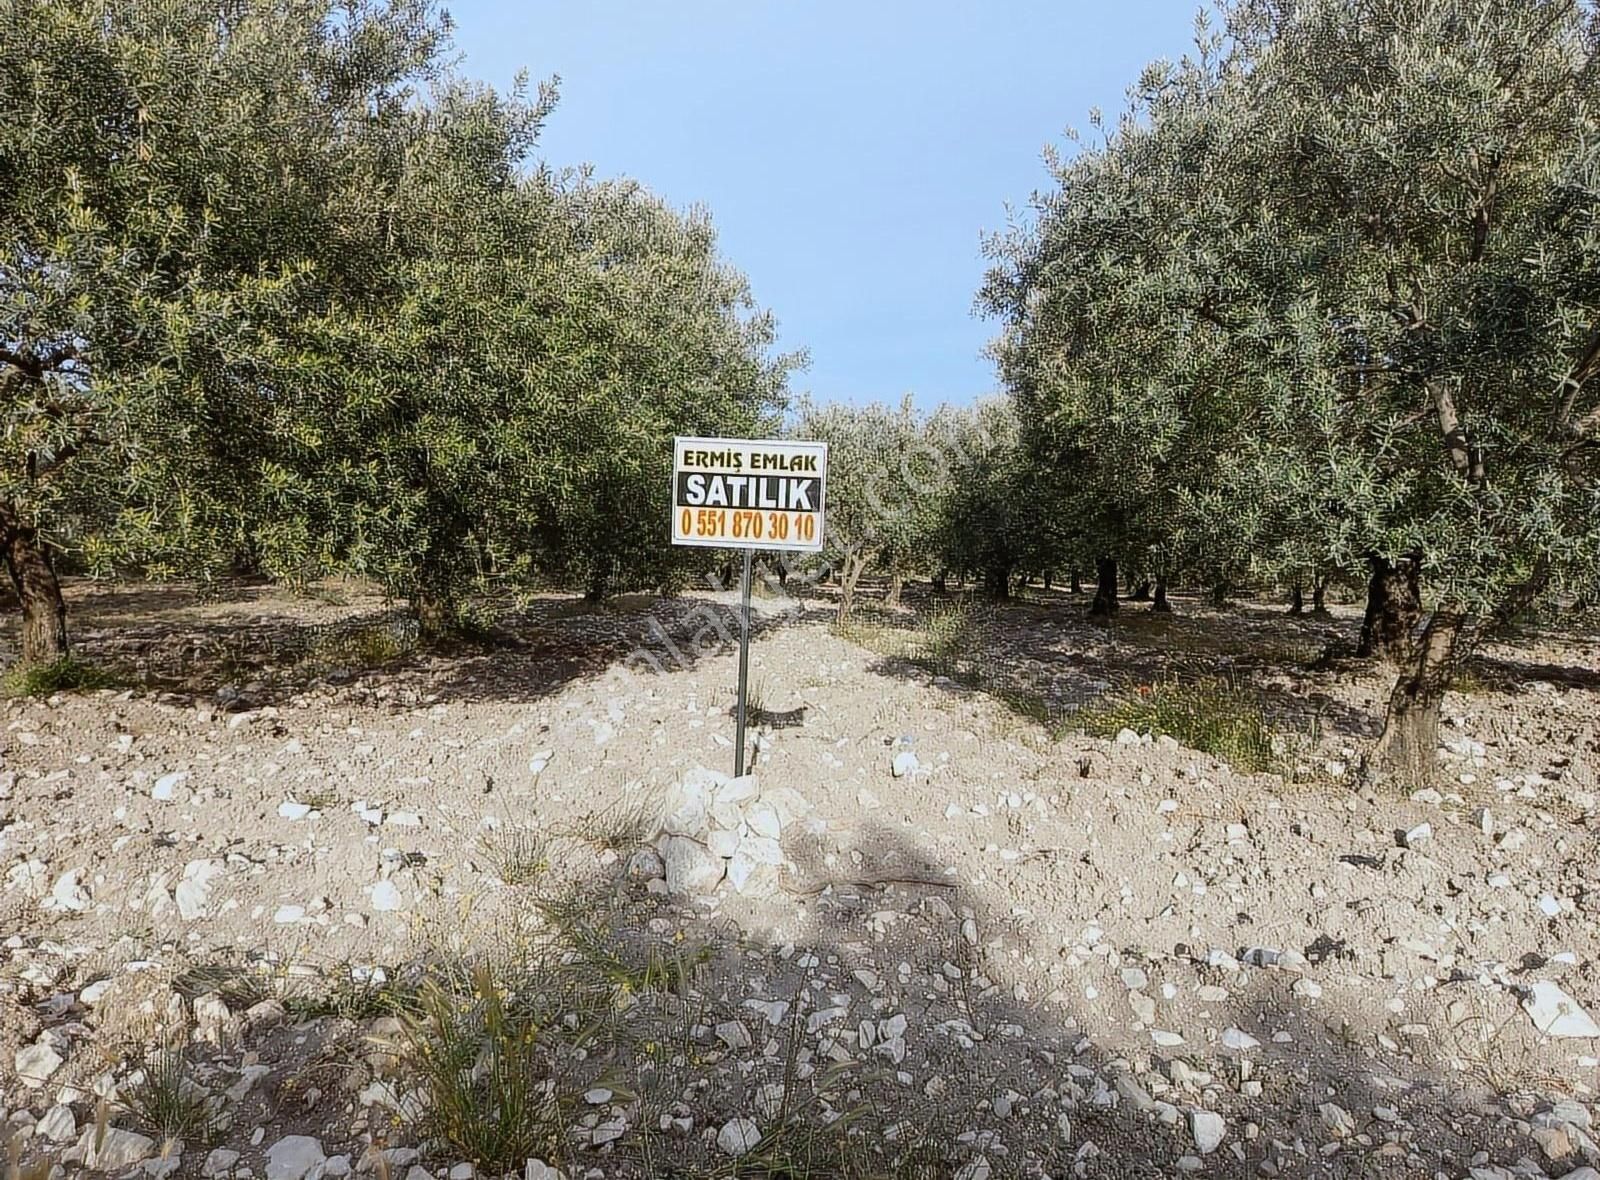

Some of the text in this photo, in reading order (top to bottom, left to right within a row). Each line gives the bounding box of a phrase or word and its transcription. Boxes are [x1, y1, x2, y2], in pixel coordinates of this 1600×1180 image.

[683, 448, 817, 473] ERMİŞ EMLAK
[686, 474, 813, 510] SATILIK
[682, 508, 814, 541] 0 551 870 30 10
